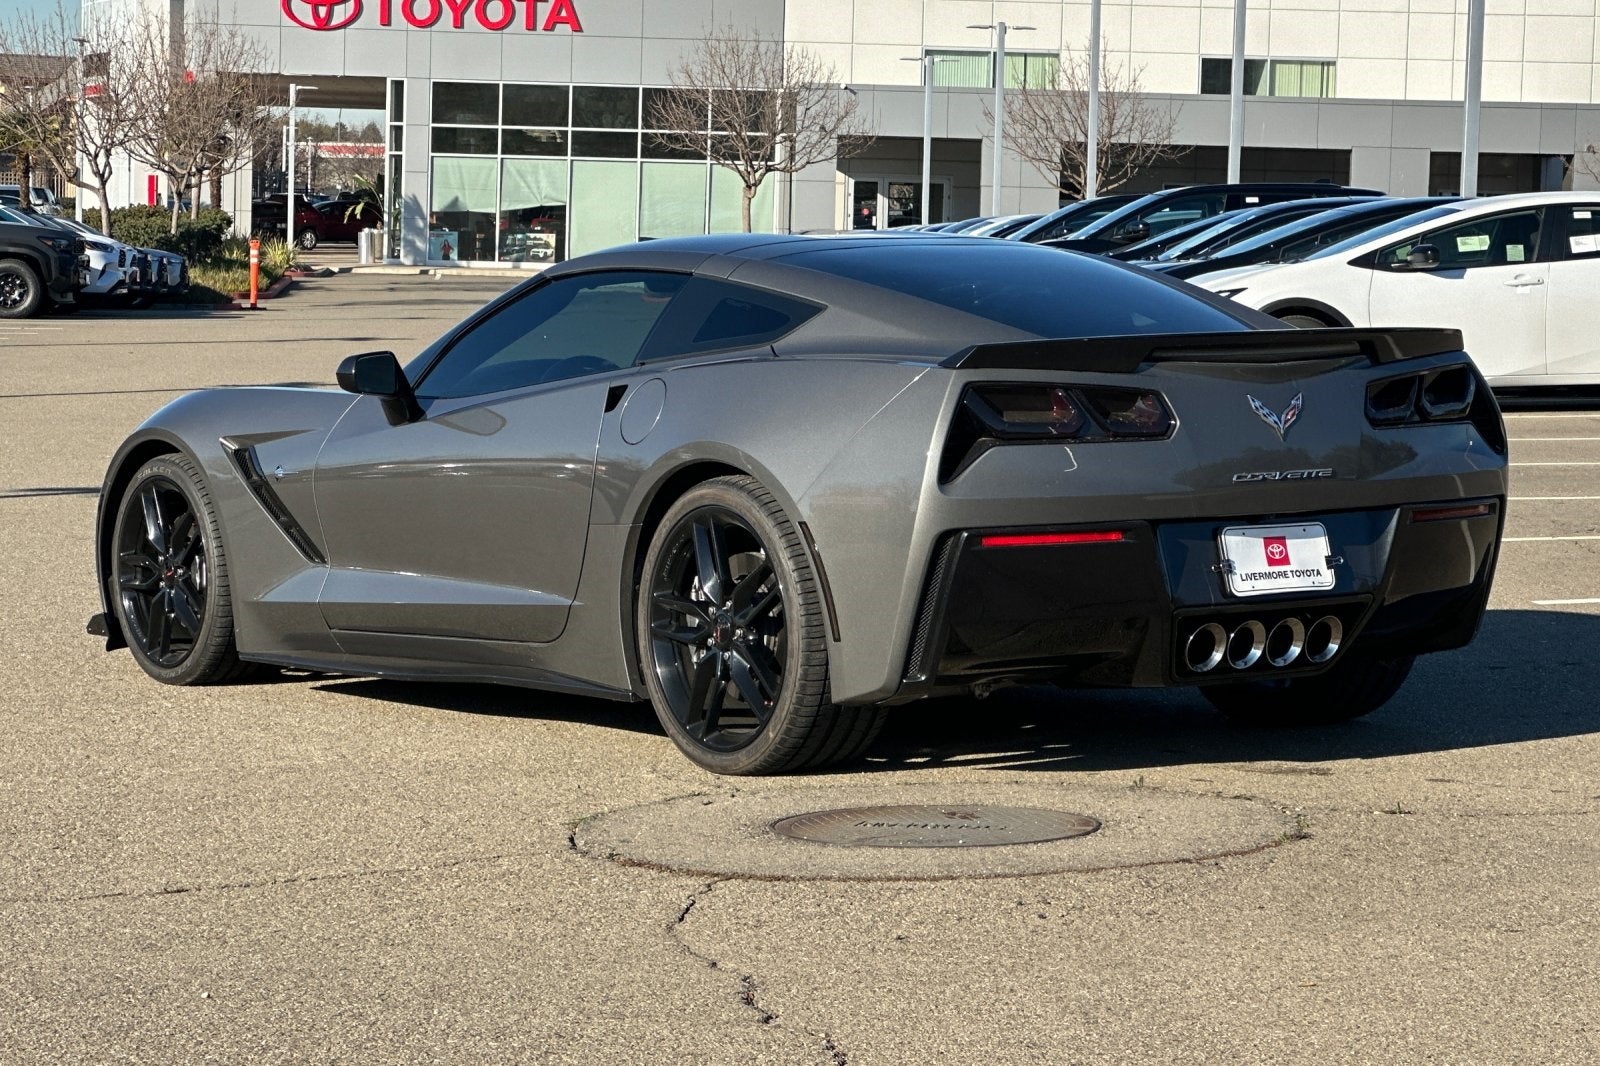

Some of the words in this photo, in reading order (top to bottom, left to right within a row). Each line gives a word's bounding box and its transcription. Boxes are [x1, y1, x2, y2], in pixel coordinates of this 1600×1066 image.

[1233, 468, 1332, 481] CORVETTE
[1240, 570, 1289, 582] LIVERMORE
[1290, 568, 1322, 578] TOYOTA
